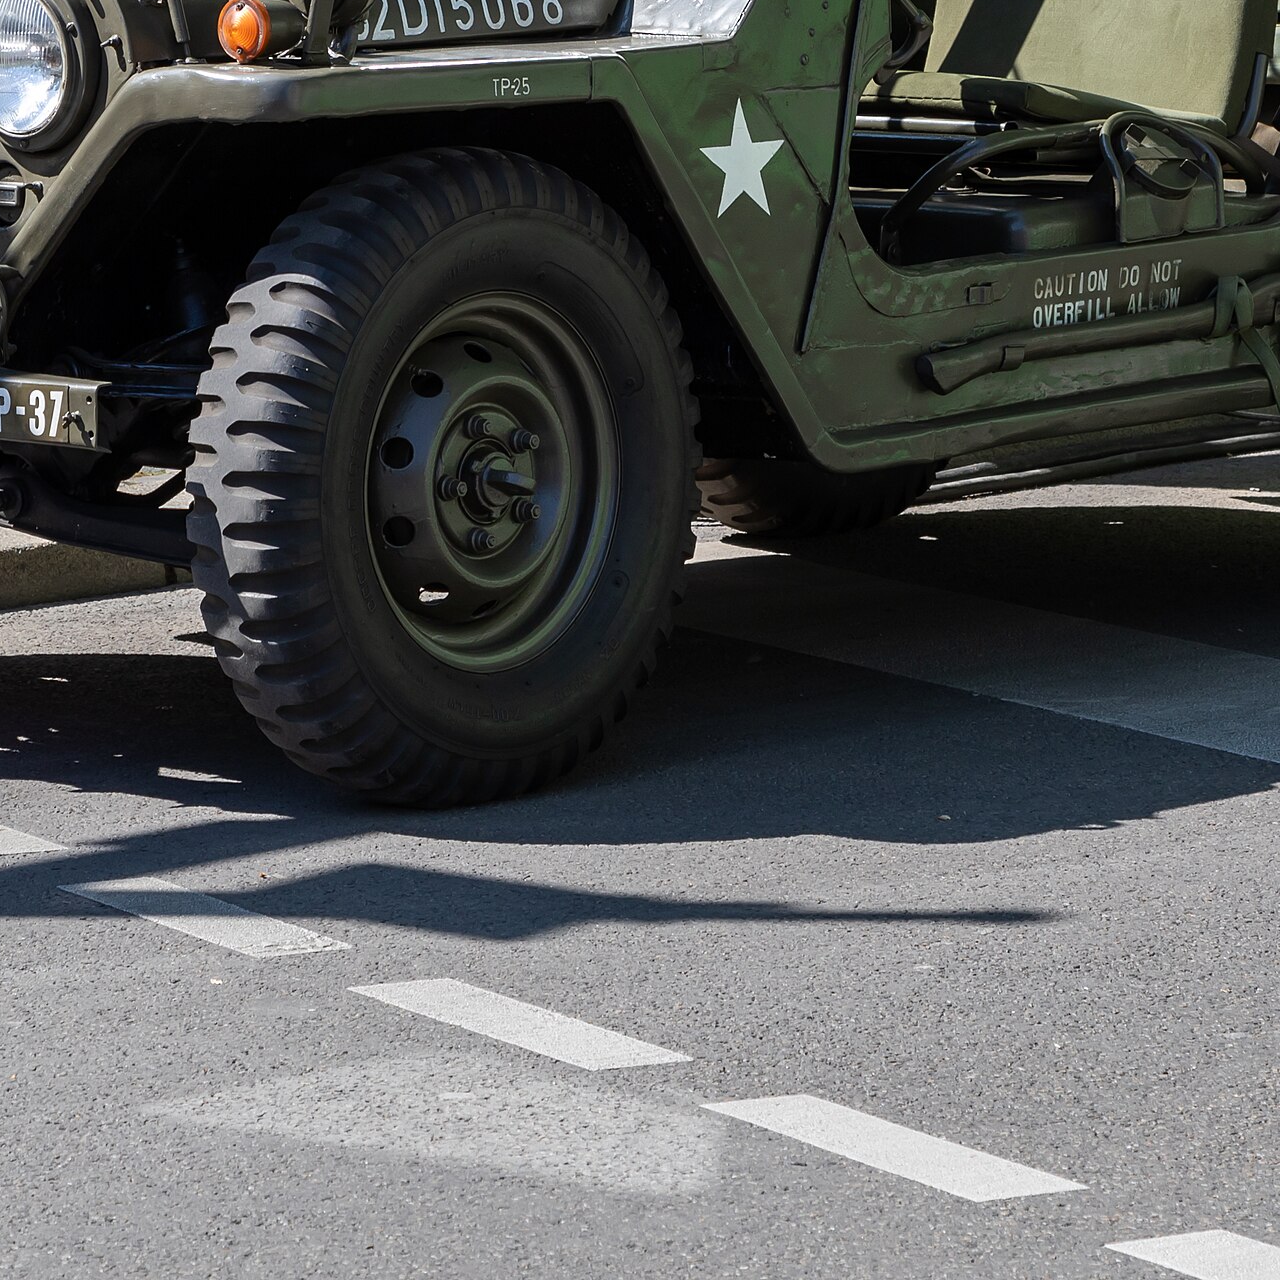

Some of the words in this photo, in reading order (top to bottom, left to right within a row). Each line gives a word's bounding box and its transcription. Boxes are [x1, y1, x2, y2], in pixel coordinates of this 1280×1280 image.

[492, 77, 531, 97] TP-25
[1034, 268, 1108, 300] CAUTION
[1119, 265, 1140, 289] DO
[1150, 259, 1182, 284] NOT
[1033, 296, 1116, 328] OVERFILL
[1127, 286, 1181, 315] ALLOW
